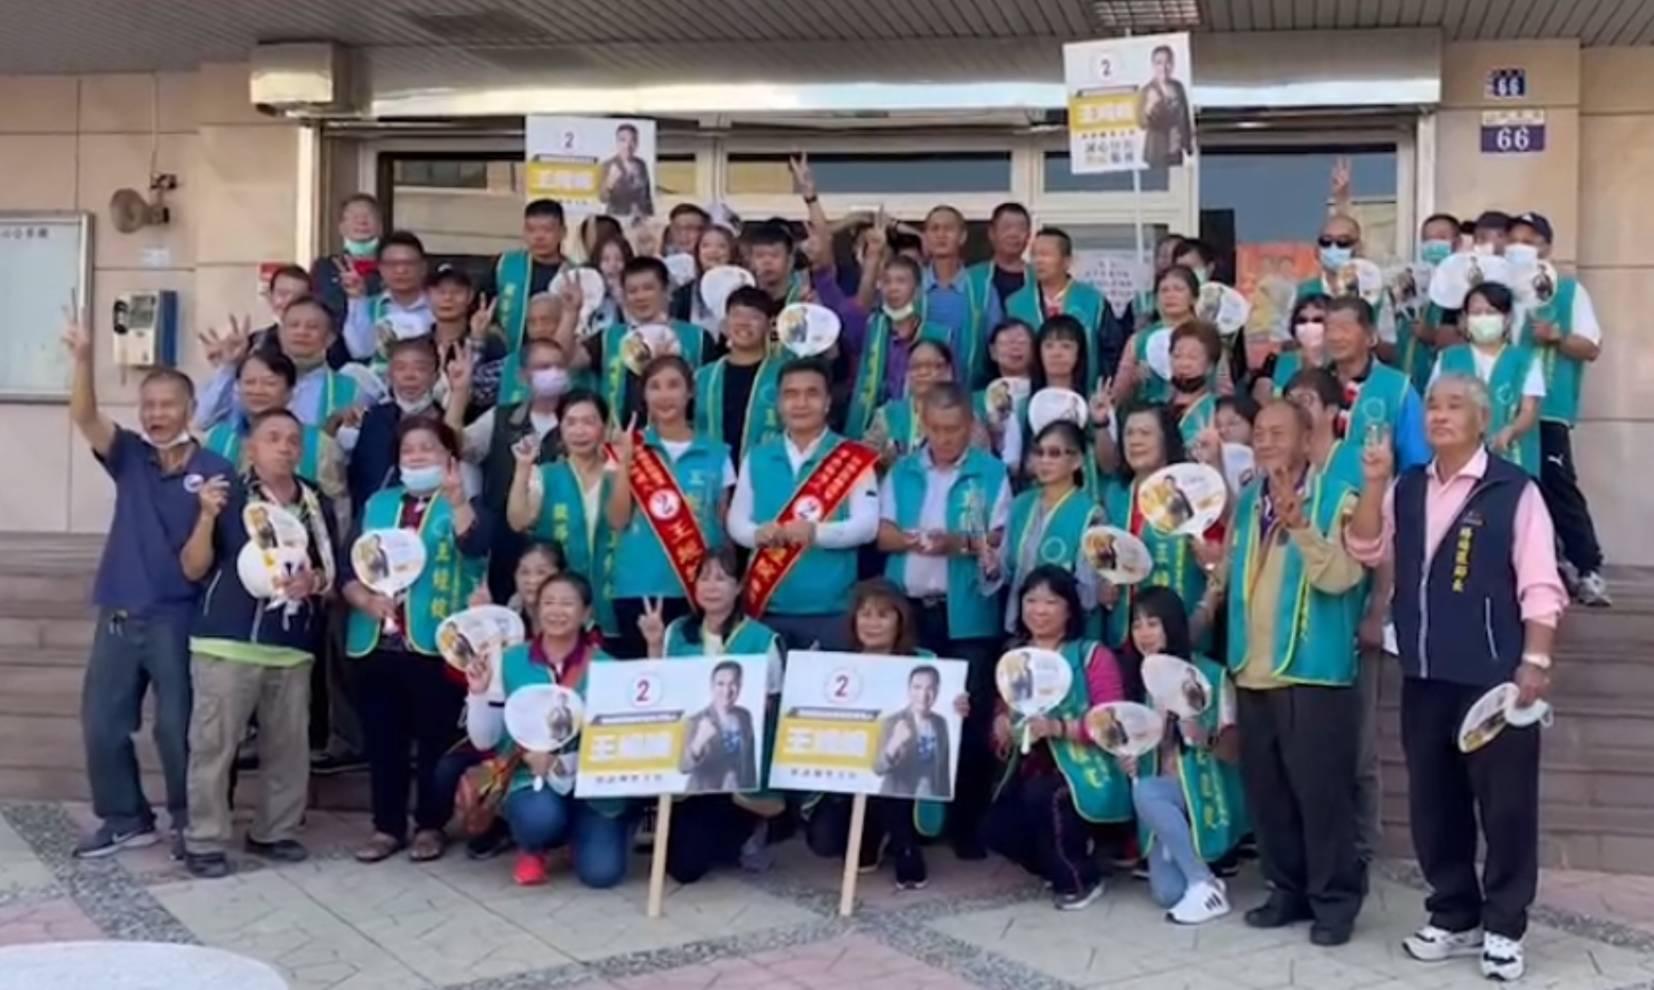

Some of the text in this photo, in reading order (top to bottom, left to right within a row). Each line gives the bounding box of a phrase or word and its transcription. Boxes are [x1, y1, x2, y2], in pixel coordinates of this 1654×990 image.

[1101, 59, 1111, 76] 2
[564, 132, 574, 148] 2
[1497, 126, 1529, 150] 66
[656, 494, 673, 514] 2
[636, 680, 650, 702] 2
[834, 675, 849, 698] 2
